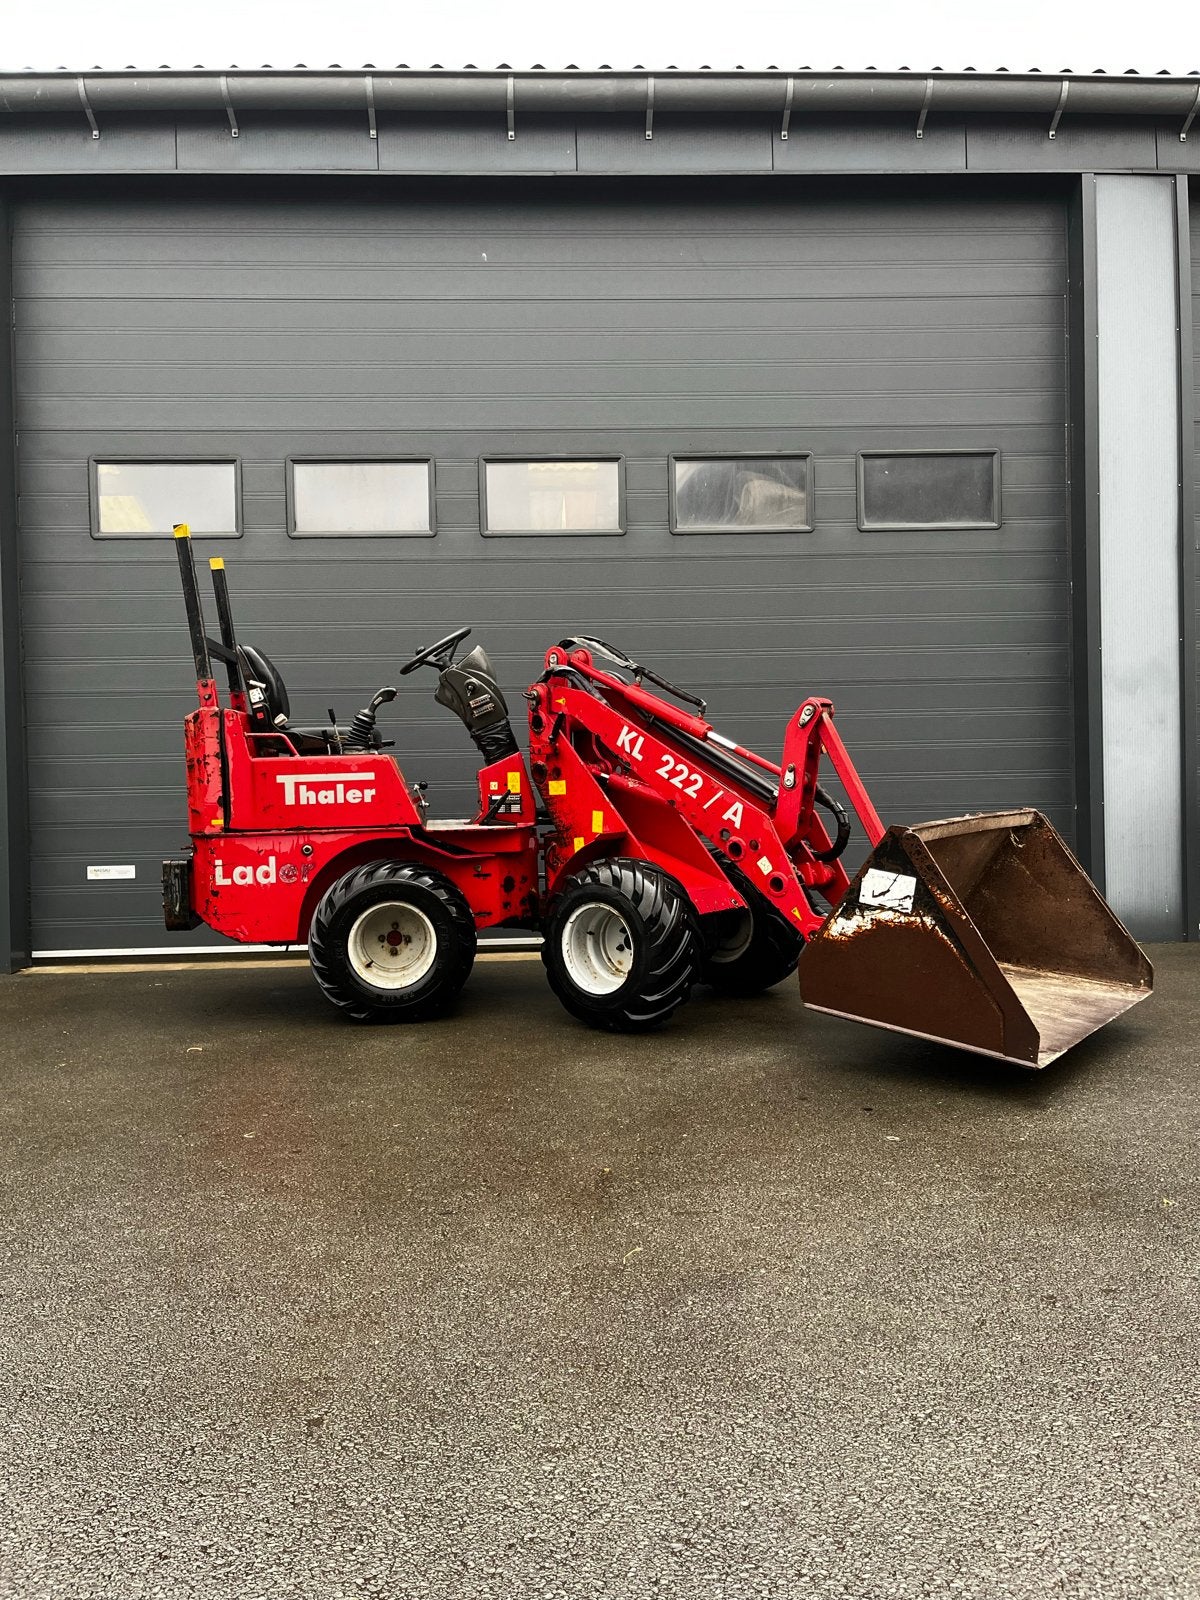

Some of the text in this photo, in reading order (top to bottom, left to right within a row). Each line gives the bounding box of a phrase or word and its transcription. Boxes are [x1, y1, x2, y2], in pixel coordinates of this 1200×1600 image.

[276, 772, 376, 805] Thaler
[616, 725, 744, 829] KL 222 / A
